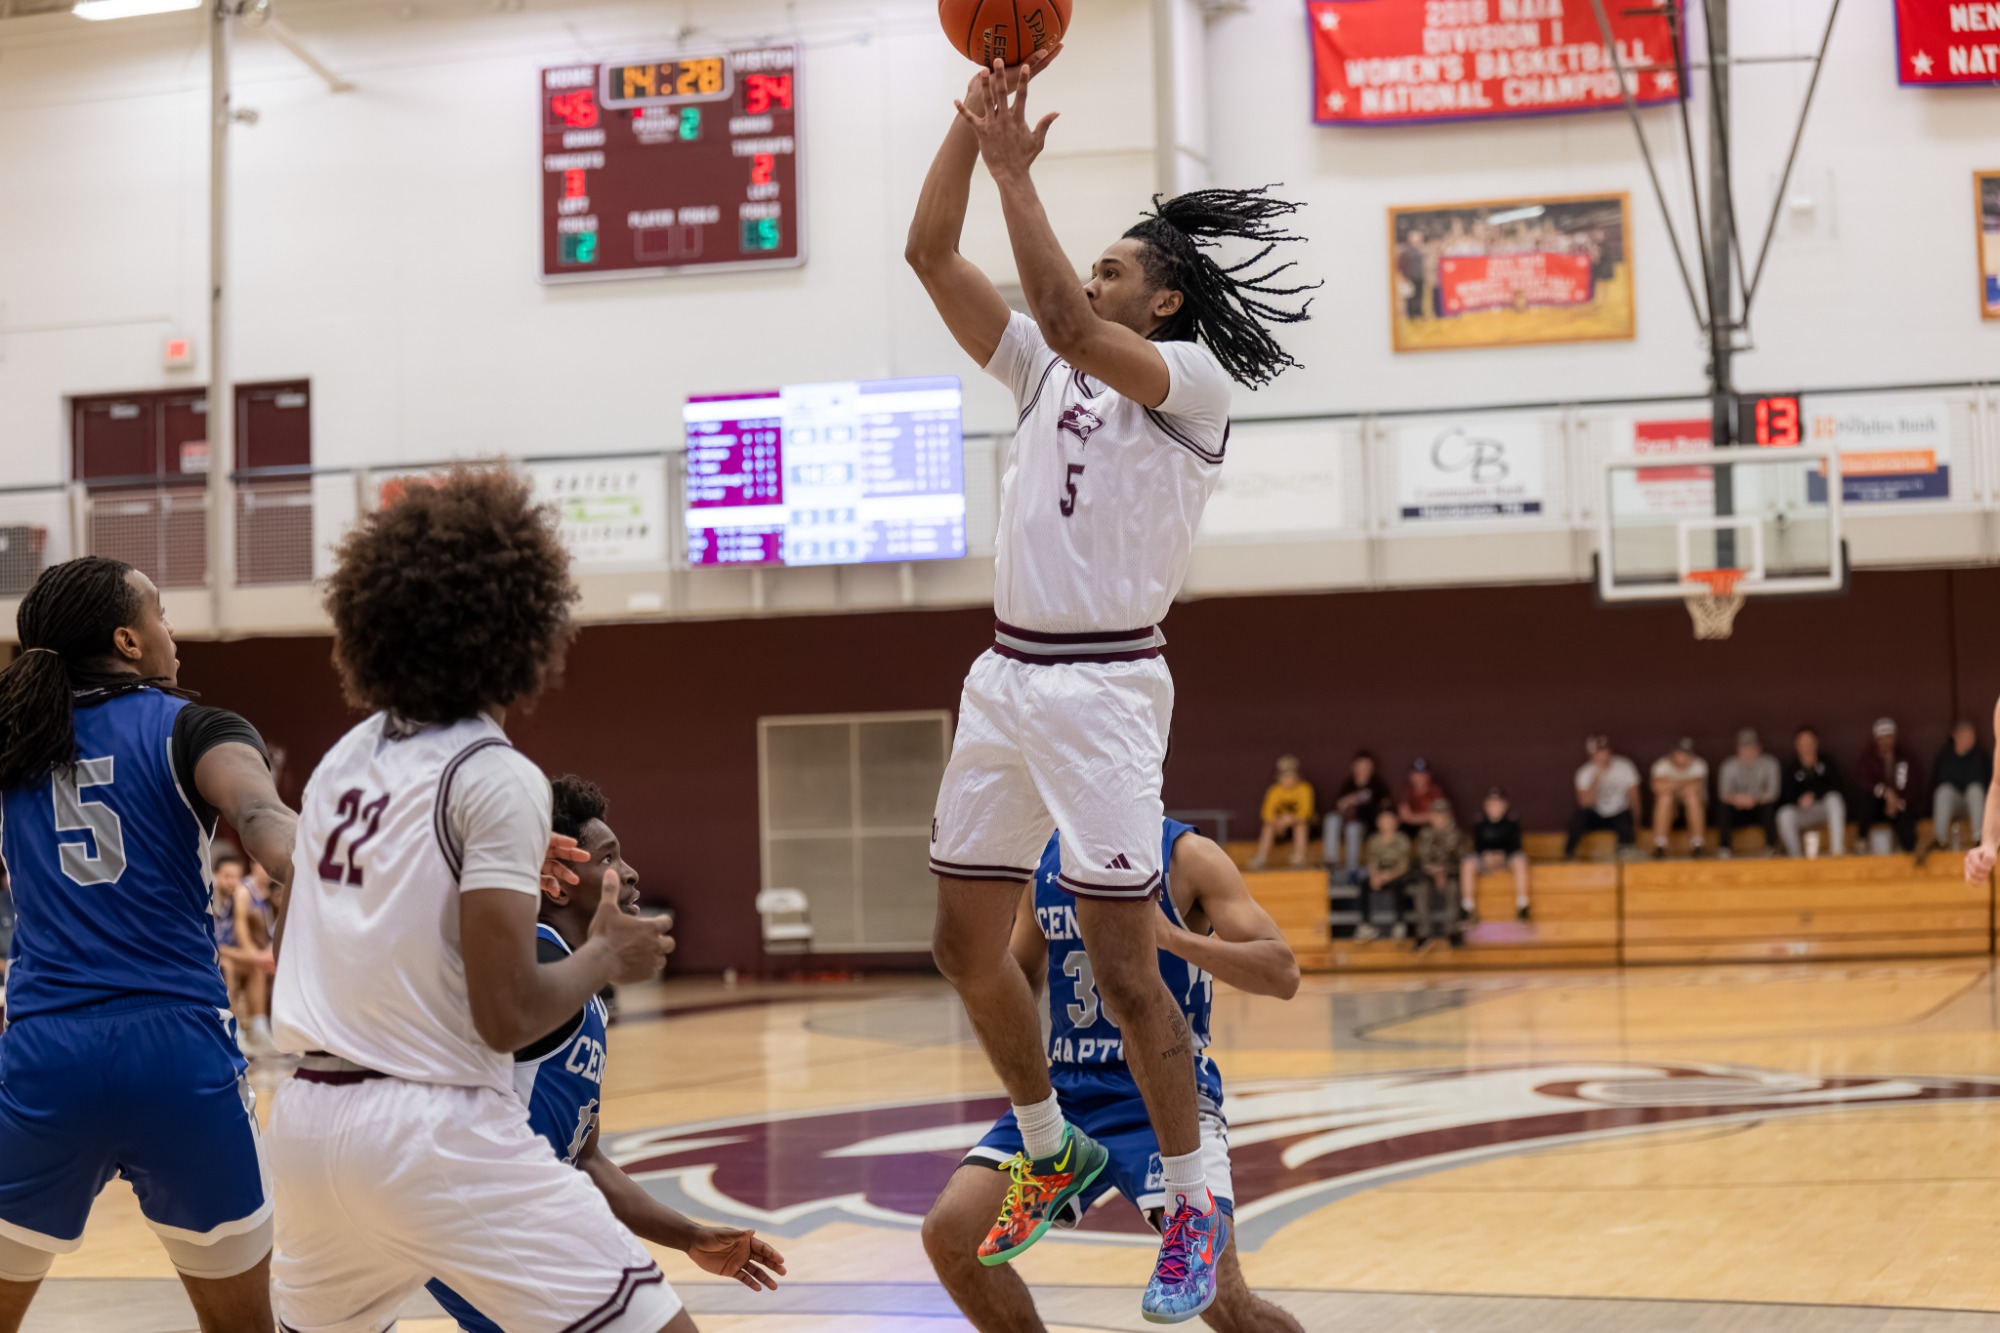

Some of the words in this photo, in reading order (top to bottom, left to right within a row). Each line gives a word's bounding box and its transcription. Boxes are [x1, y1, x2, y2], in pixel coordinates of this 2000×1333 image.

[1422, 23, 1540, 55] DIVISION
[623, 57, 722, 99] 14:28
[1344, 53, 1464, 87] WOMEN'S
[1474, 38, 1653, 80] BASKETBALL
[746, 73, 792, 114] 34
[1360, 81, 1492, 115] NATIONAL
[679, 106, 700, 140] 2
[752, 152, 774, 185] 2
[576, 232, 597, 263] 2
[758, 217, 779, 249] 5
[1755, 396, 1799, 447] 13
[1060, 463, 1085, 517] 5
[52, 755, 127, 886] 5
[318, 788, 390, 888] 22
